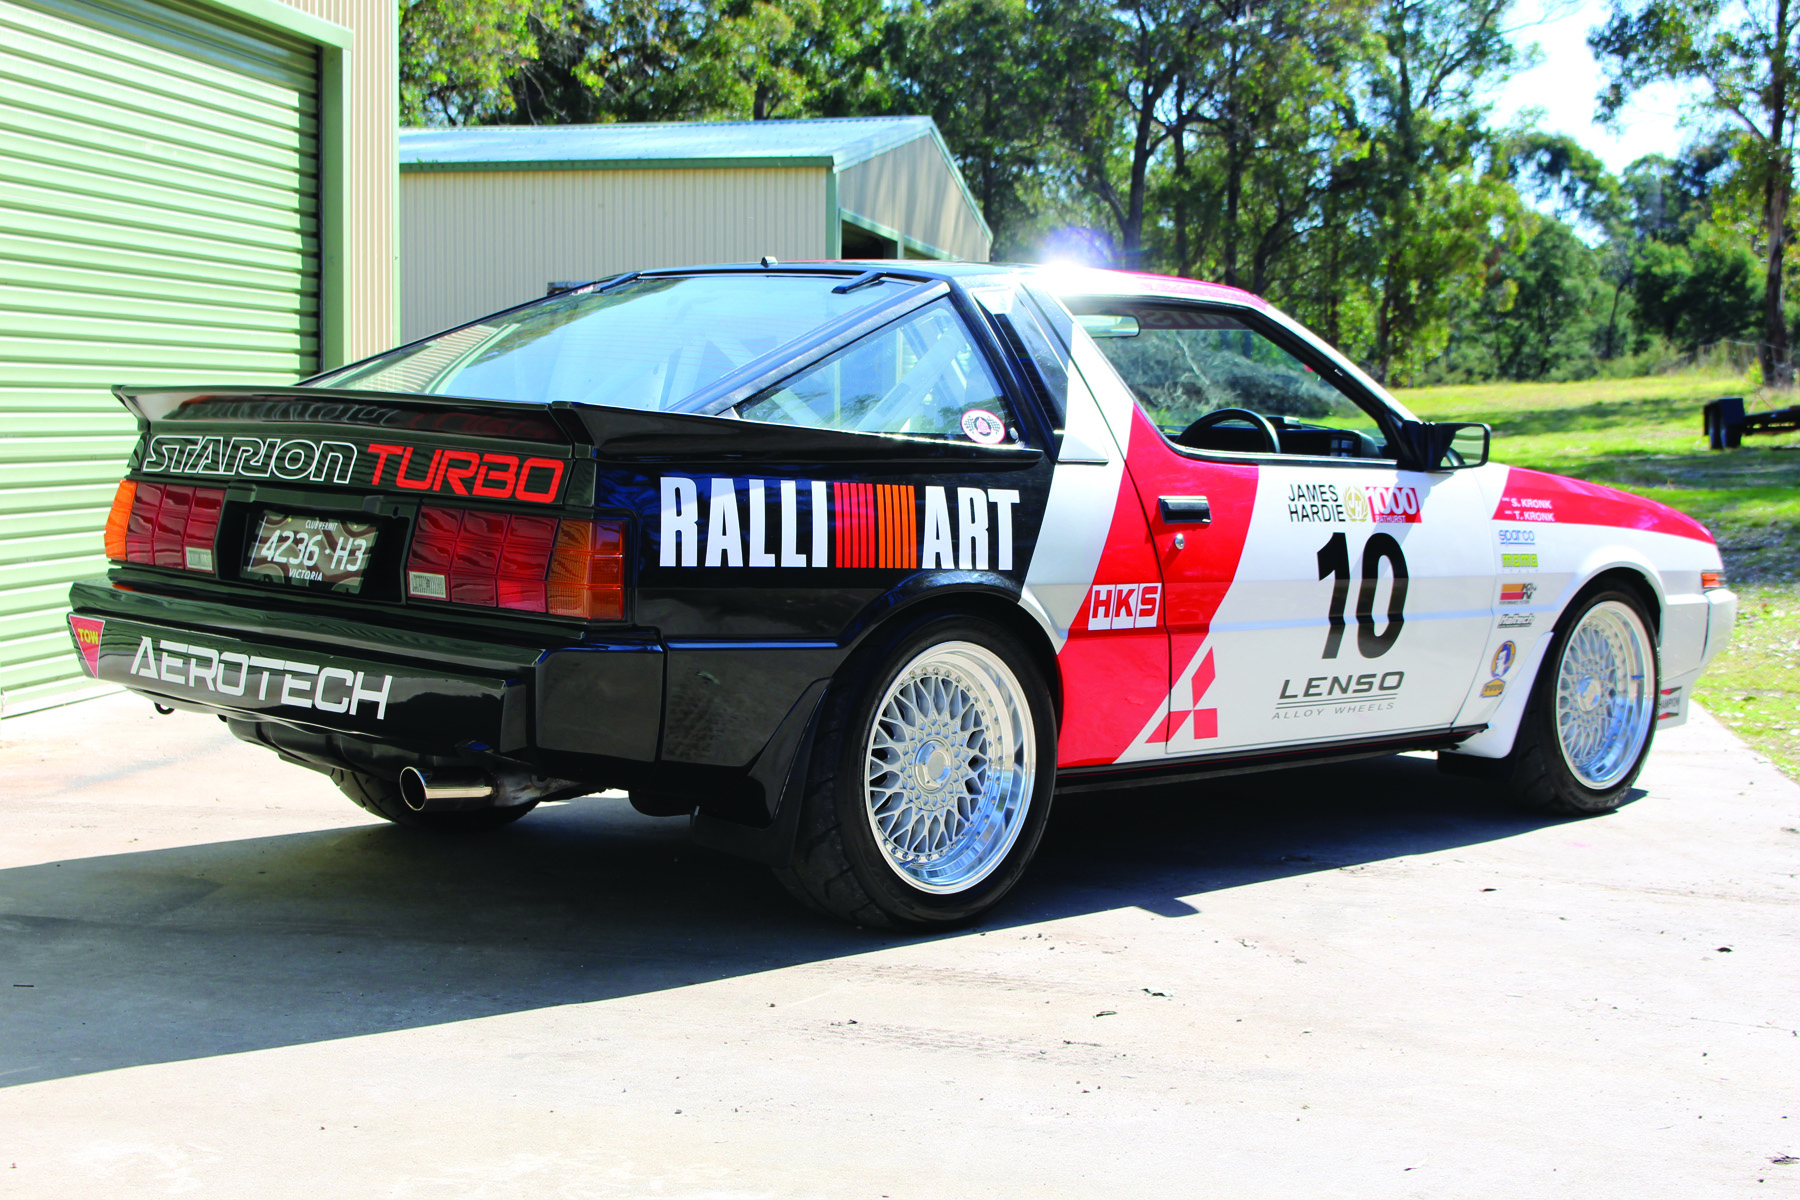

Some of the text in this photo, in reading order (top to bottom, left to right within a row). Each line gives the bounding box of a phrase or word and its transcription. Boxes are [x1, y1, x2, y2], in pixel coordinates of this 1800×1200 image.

[367, 443, 565, 503] TURBO
[1288, 484, 1339, 502] JAMES
[1364, 486, 1418, 515] 1000
[659, 476, 1020, 571] RALLI ART
[1288, 504, 1346, 522] HARDIE
[305, 519, 338, 532] CLUB PERMIT
[1499, 529, 1536, 546] sparco
[289, 568, 323, 581] VICTORIA
[1091, 585, 1160, 619] HKS
[1317, 532, 1409, 659] 10
[77, 627, 99, 645] TOW
[130, 635, 393, 720] AEROTECH
[1279, 671, 1405, 700] LENSO
[1272, 702, 1395, 720] ALLOY WHEELS
